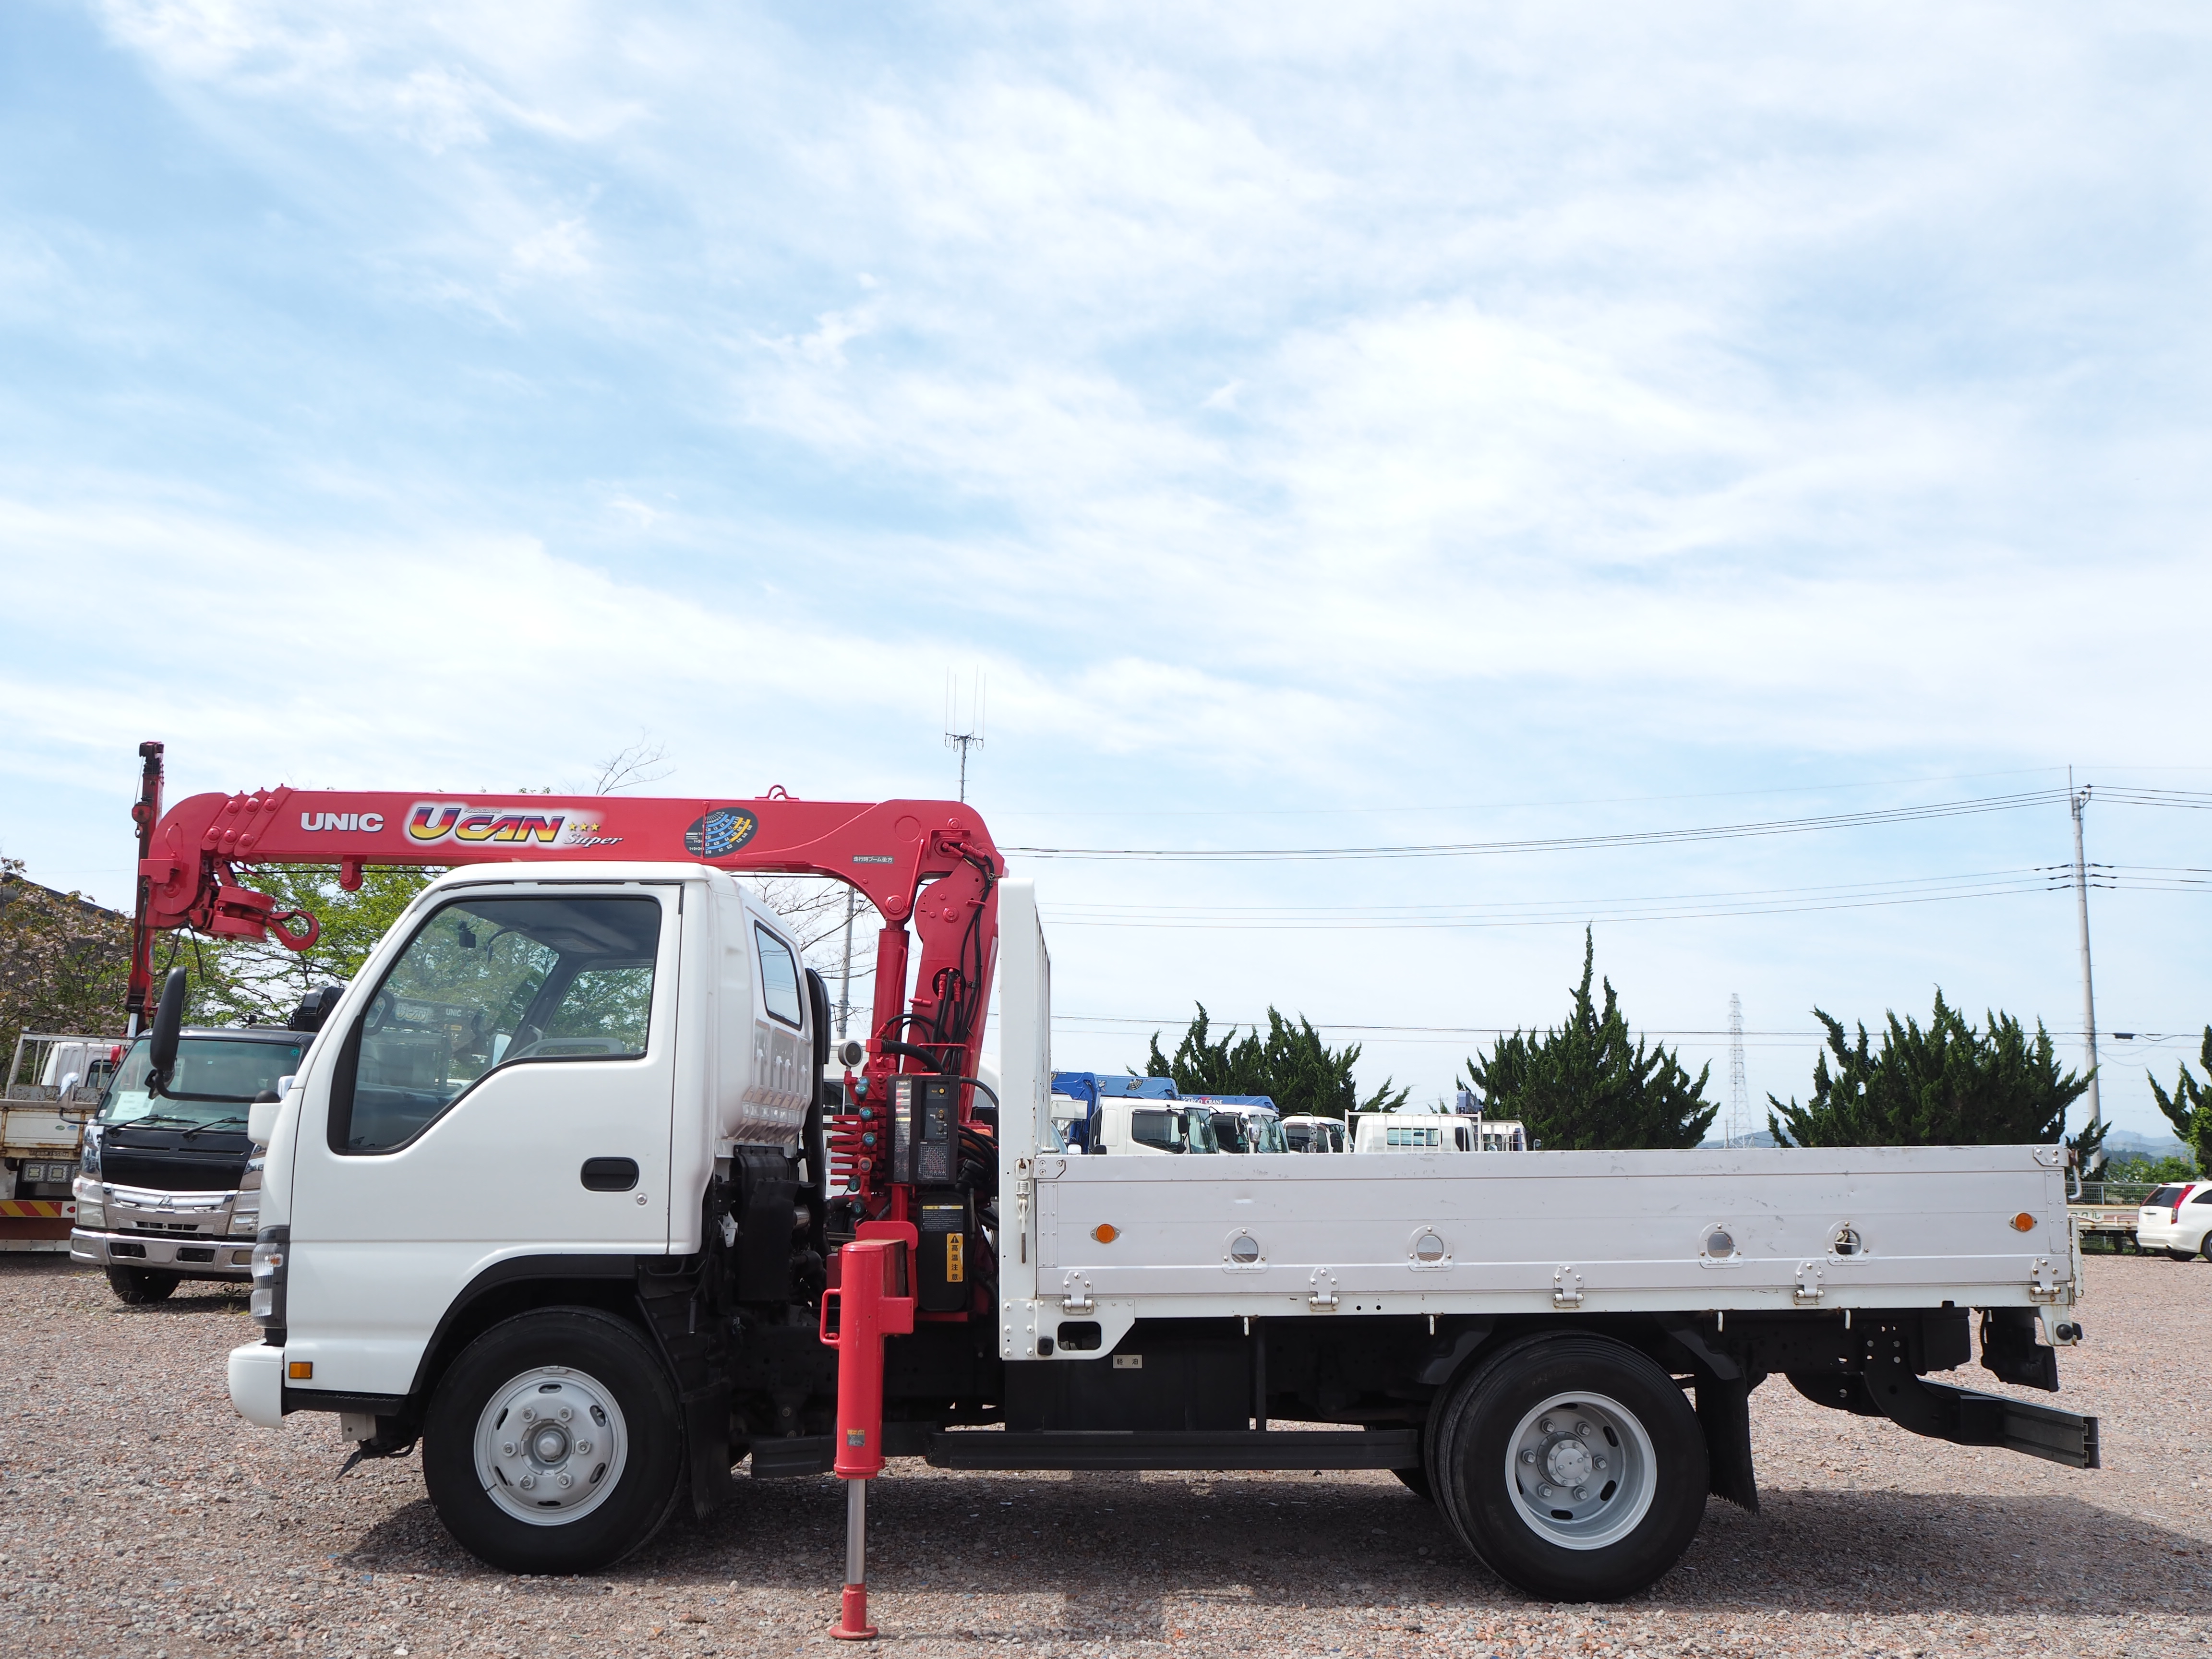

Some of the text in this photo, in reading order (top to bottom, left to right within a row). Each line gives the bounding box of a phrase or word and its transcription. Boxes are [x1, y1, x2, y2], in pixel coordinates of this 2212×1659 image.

[301, 812, 384, 832] UNIC
[409, 807, 565, 842] UCAN
[563, 832, 624, 848] Super
[446, 1009, 461, 1017] UNIC
